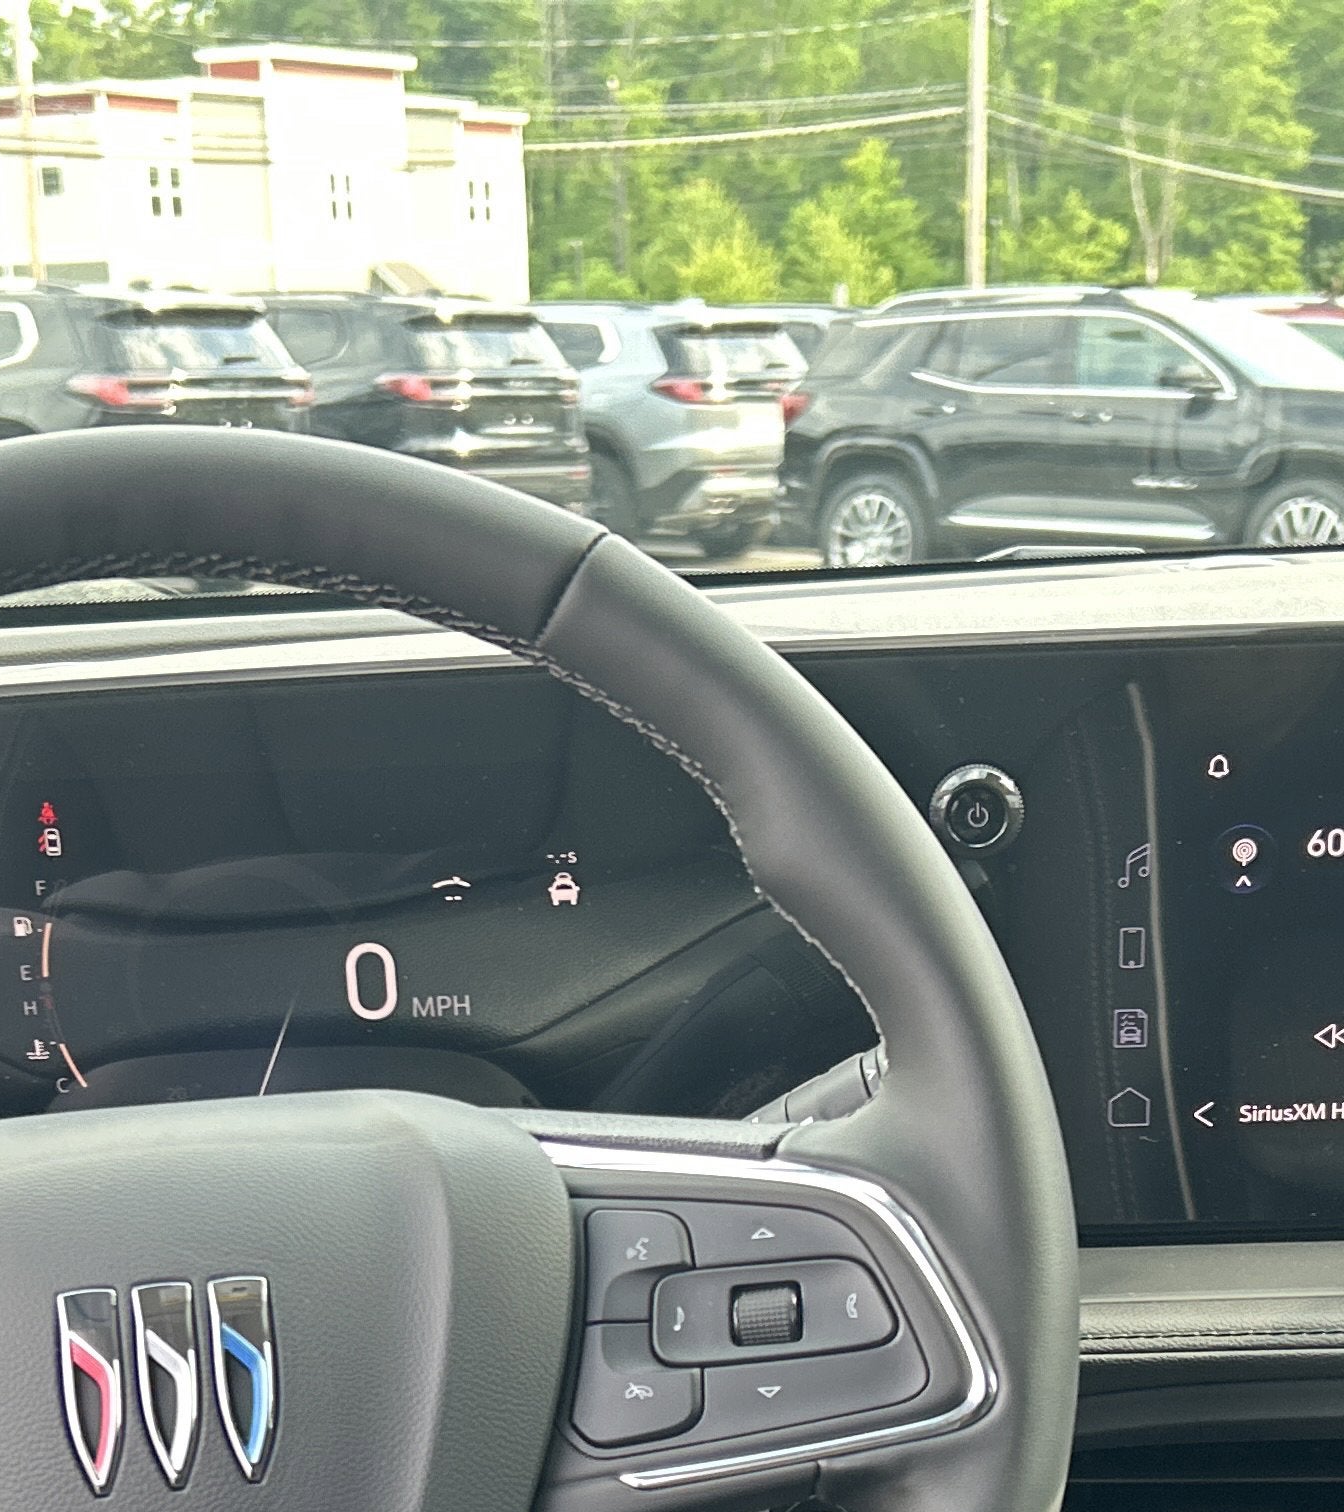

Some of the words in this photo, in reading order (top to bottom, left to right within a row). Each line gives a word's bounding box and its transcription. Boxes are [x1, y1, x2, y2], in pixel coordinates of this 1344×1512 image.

[35, 880, 47, 896] F
[20, 964, 33, 981] E
[345, 942, 398, 1020] 0
[412, 995, 472, 1018] MPH
[23, 1001, 38, 1016] H
[56, 1077, 70, 1094] C
[1239, 1102, 1326, 1123] SiriusXM
